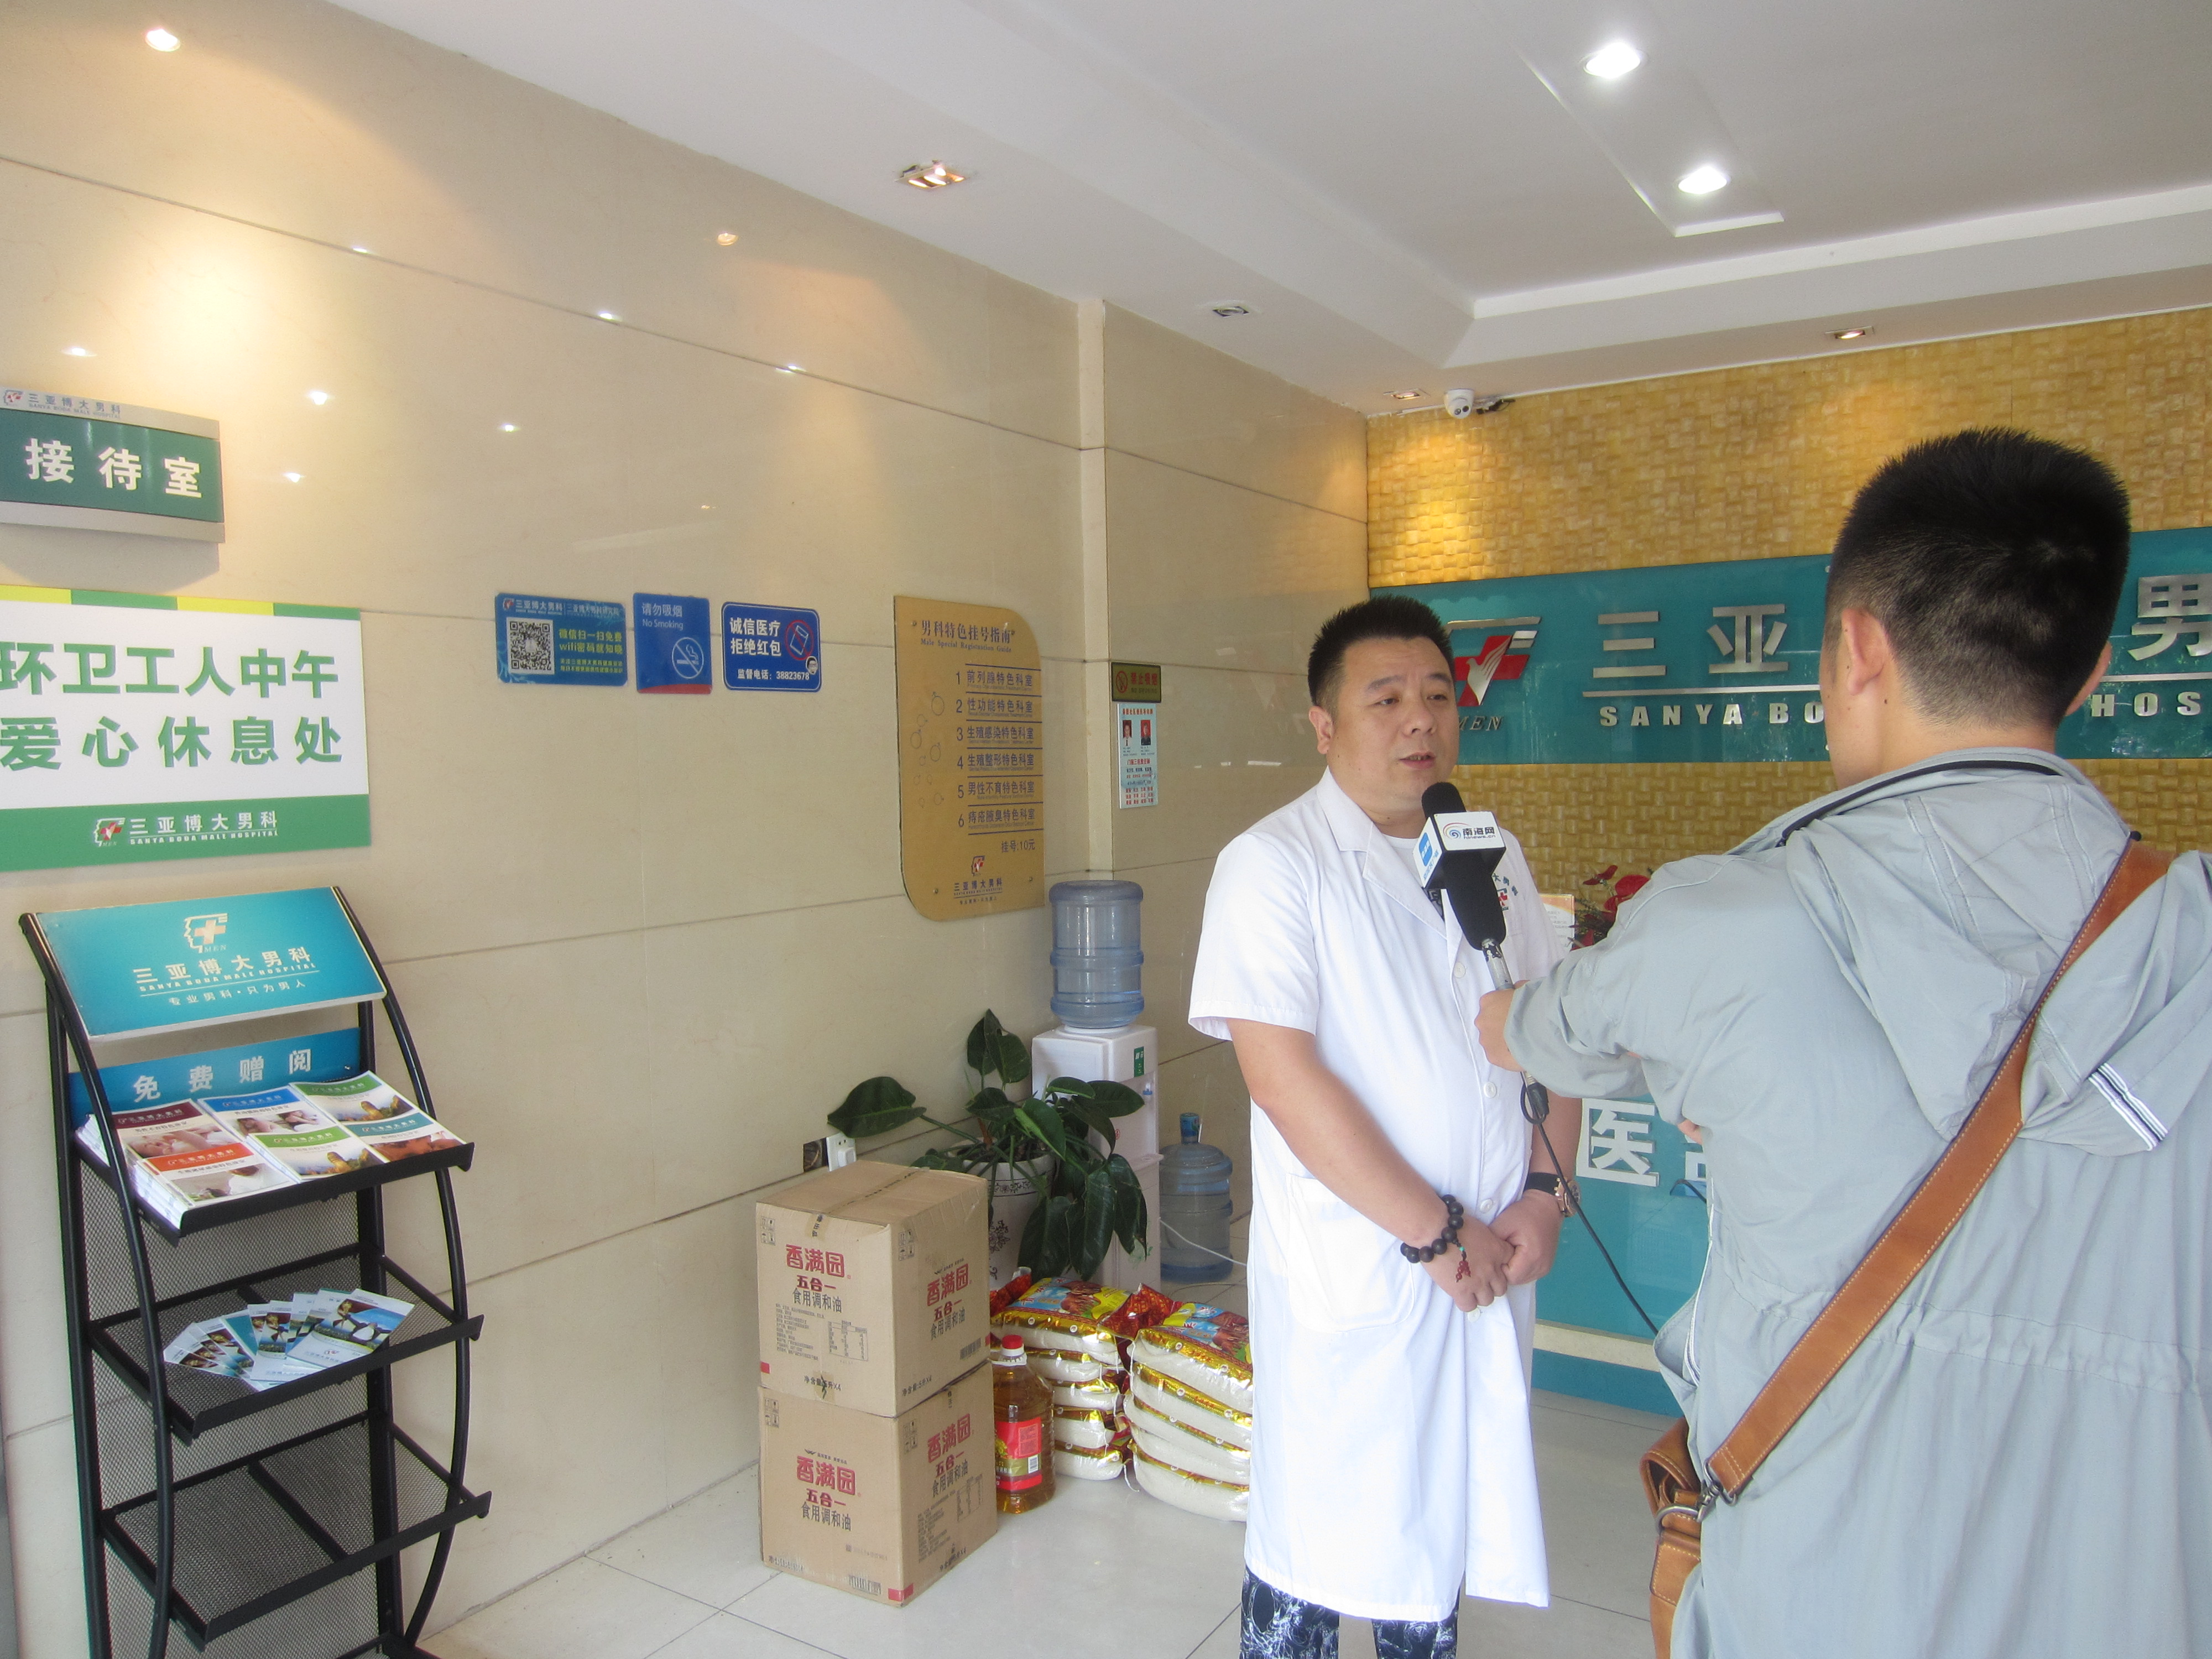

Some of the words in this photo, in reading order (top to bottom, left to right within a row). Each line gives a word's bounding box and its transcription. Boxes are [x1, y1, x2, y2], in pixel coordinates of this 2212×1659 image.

[25, 438, 202, 498] 接待室
[642, 602, 682, 617] 请勿吸烟
[559, 629, 622, 642] 微信扫一扫免费
[642, 619, 653, 627] No
[654, 619, 684, 631] Smoking
[729, 617, 781, 637] 诚信医疗
[922, 620, 1011, 644] 男科特色挂号指南
[731, 638, 781, 656] 拒绝红包
[0, 641, 338, 698] 环卫工人中午
[776, 671, 810, 681] 38823678
[956, 671, 961, 685] 1
[967, 670, 1032, 687] 前列腺特色科室
[1131, 671, 1157, 686] 禁止吸烟
[956, 699, 962, 713] 2
[967, 697, 1033, 713] 性功能特色科室
[1599, 702, 1744, 727] SANYA
[1768, 700, 1825, 725] BO
[0, 716, 342, 771] 爱心休息处
[957, 727, 963, 741] 3
[967, 726, 1034, 739] 生殖感染特色科室
[957, 756, 963, 769] 4
[968, 753, 1034, 766] 生殖整形特色科室
[958, 785, 964, 799] 5
[968, 780, 1035, 795] 男性不育特色科室
[129, 811, 277, 835] 三亚博大男科
[958, 813, 964, 827] 6
[968, 808, 1035, 824] 痔疮腋臭特色科室
[130, 836, 165, 845] SANYA
[231, 830, 278, 839] HOSPITAL
[1463, 827, 1495, 836] 南海网
[1001, 838, 1035, 853] 挂号:10元
[204, 945, 227, 953] MEN
[133, 946, 311, 984] 三亚博大男科
[139, 981, 181, 992] SANYA
[186, 976, 220, 985] BODA
[224, 971, 254, 980] MALE
[259, 963, 317, 975] HOSPITAL
[133, 1048, 312, 1103] 免费赠阅
[1576, 1098, 1710, 1187] 医
[786, 1244, 845, 1277] 香满园
[796, 1274, 836, 1292] 五合一
[927, 1263, 969, 1307] 香满园
[792, 1287, 842, 1313] 食用调和油
[934, 1299, 962, 1322] 五合一
[930, 1307, 966, 1340] 食用调和油
[927, 1413, 971, 1463] 香满园
[797, 1455, 855, 1495] 香满园
[935, 1451, 964, 1478] 五合一
[932, 1459, 968, 1498] 食用调和油
[806, 1488, 846, 1507] 五合一
[801, 1501, 851, 1531] 食用调和油
